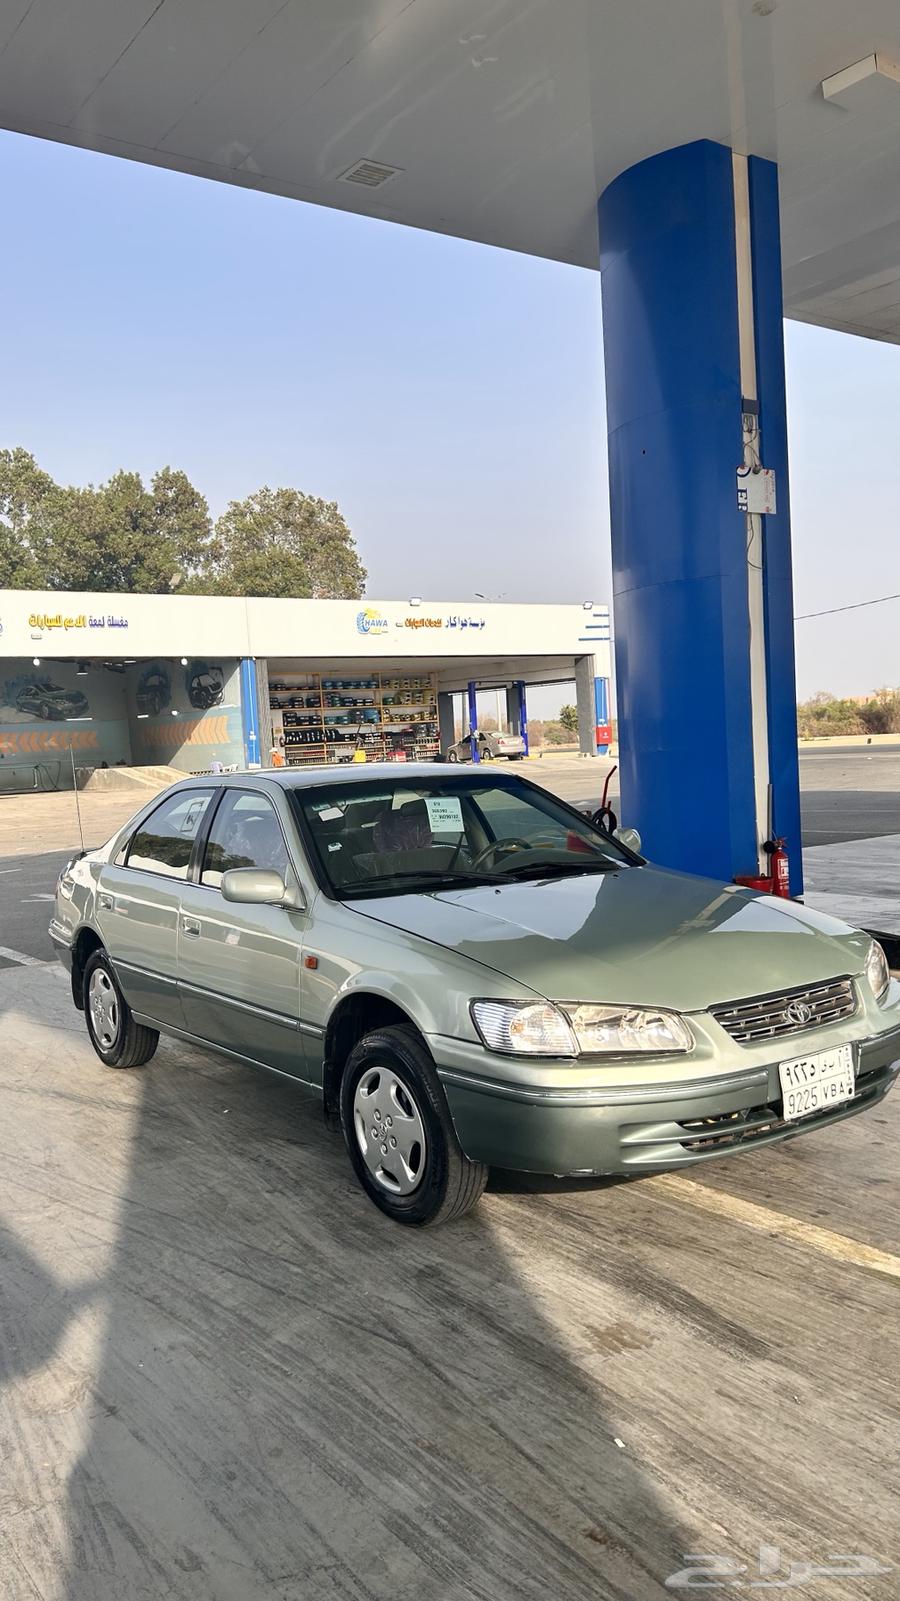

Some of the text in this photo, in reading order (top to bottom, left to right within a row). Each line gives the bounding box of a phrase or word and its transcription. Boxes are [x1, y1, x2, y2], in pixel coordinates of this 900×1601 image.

[28, 614, 62, 630] للسيارات
[88, 615, 105, 627] لمعة
[108, 615, 128, 627] مغسلة
[364, 619, 388, 627] HAWA
[788, 1081, 845, 1115] 9225 VBA
